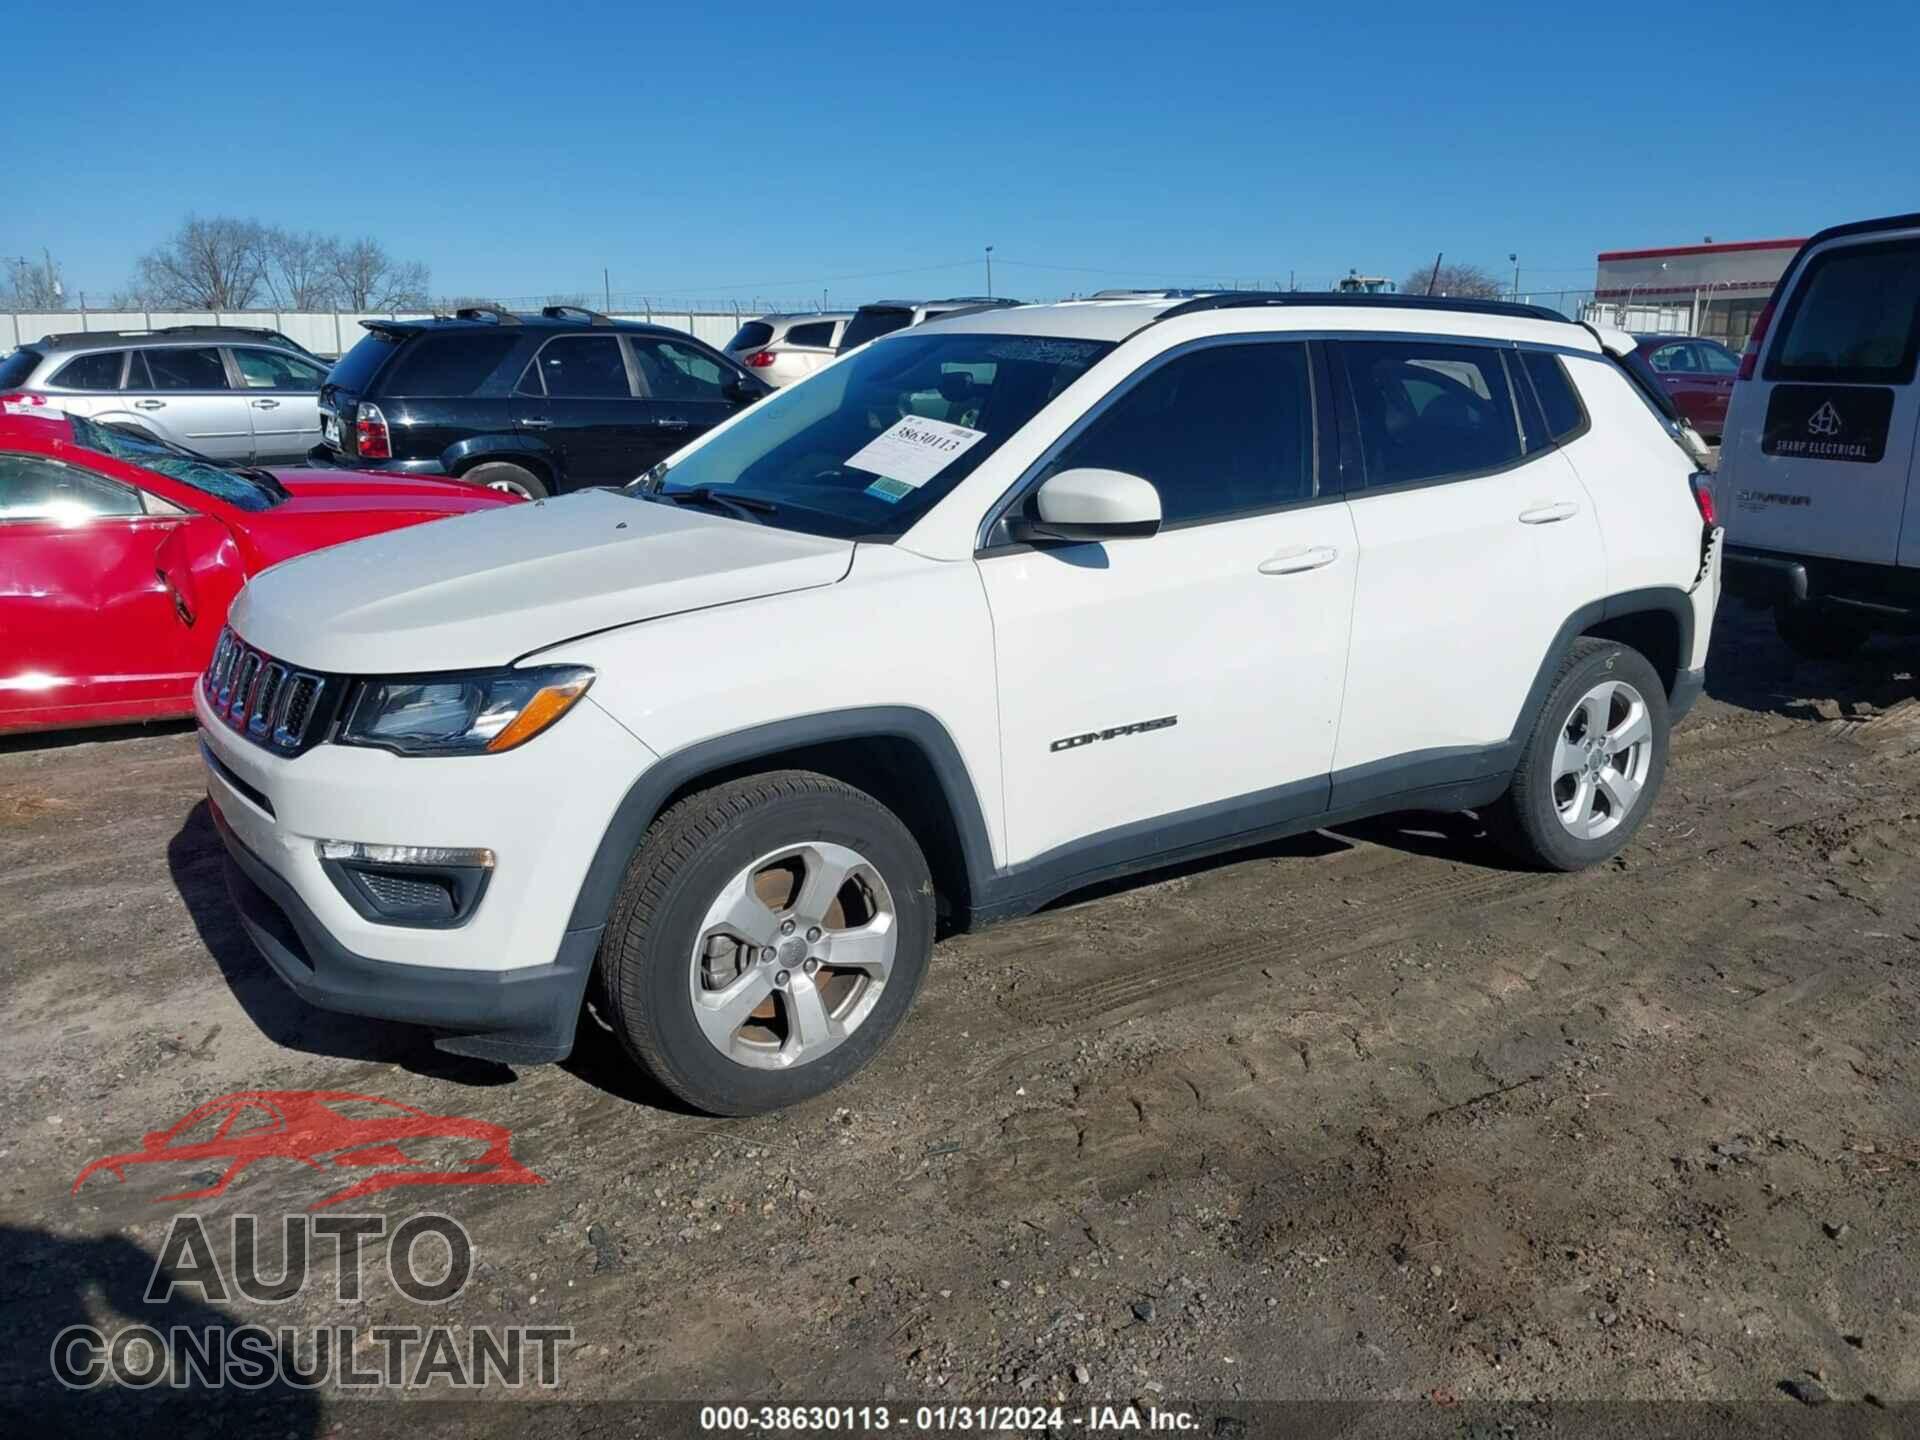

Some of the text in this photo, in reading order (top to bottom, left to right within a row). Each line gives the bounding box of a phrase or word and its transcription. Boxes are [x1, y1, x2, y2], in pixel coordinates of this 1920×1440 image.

[895, 426, 960, 452] 38630113
[1776, 440, 1867, 457] SHARP ELECTRICAL
[1051, 715, 1178, 752] COMPASS
